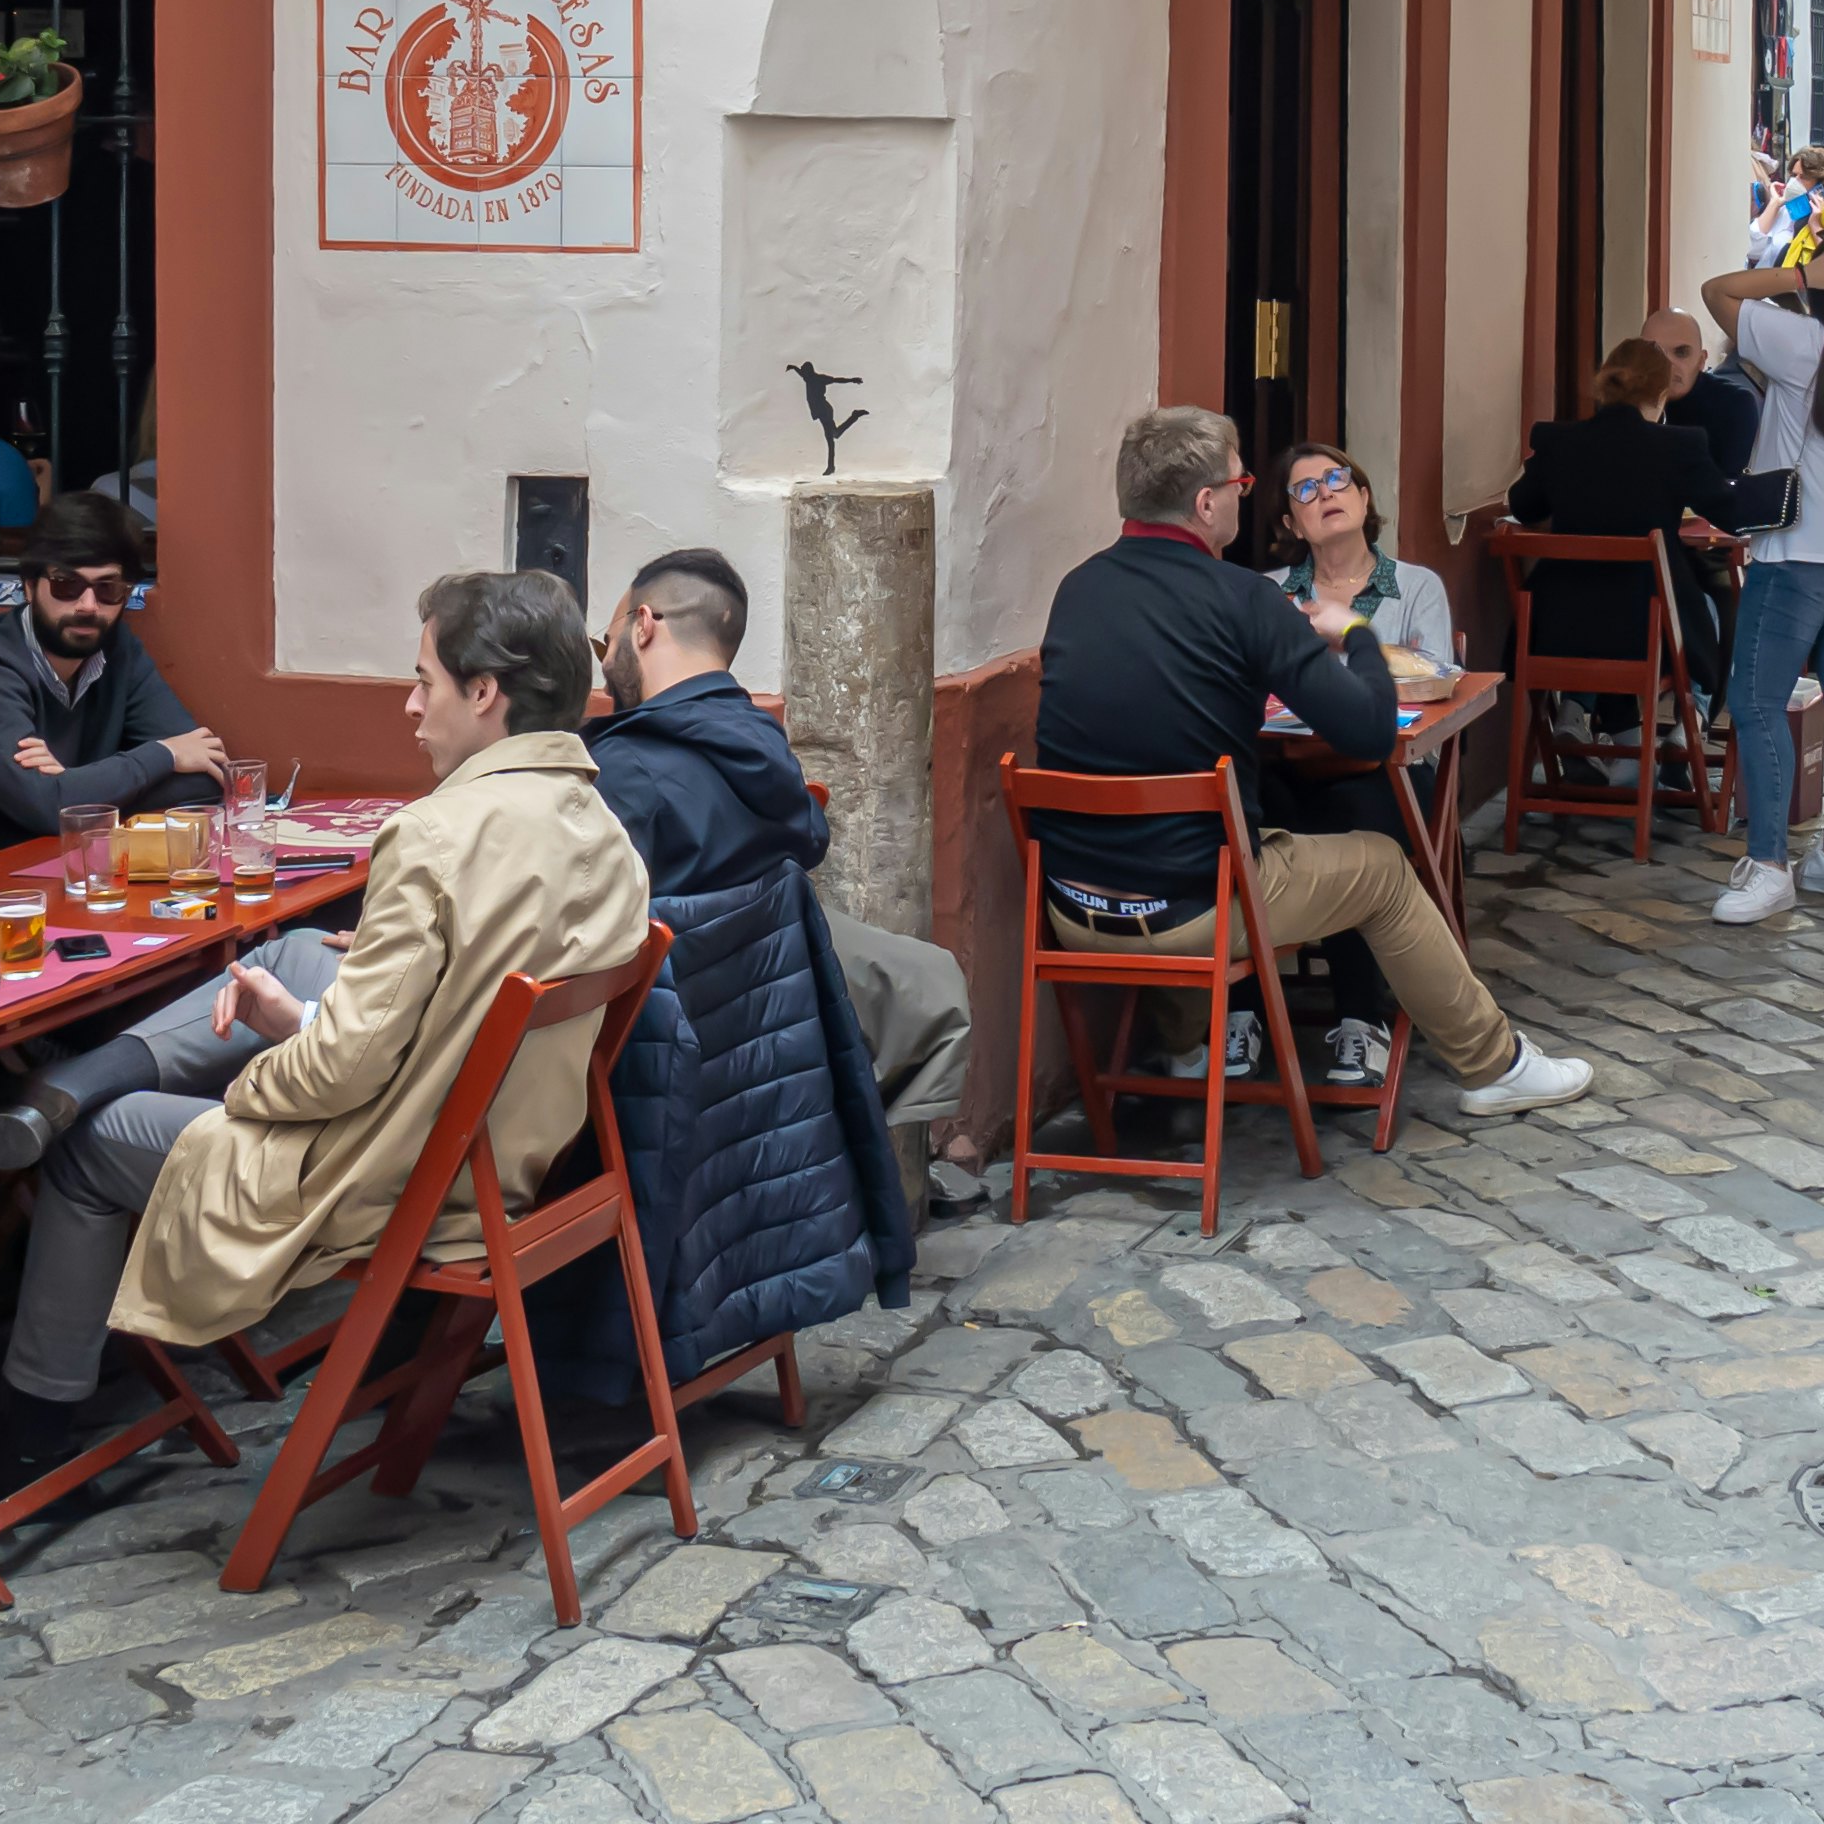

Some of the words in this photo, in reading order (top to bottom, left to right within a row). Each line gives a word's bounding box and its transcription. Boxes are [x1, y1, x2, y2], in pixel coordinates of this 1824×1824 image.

[338, 7, 394, 95] BAR
[385, 162, 475, 223] FUNDADA
[484, 198, 510, 223] EN
[517, 172, 563, 214] 1870
